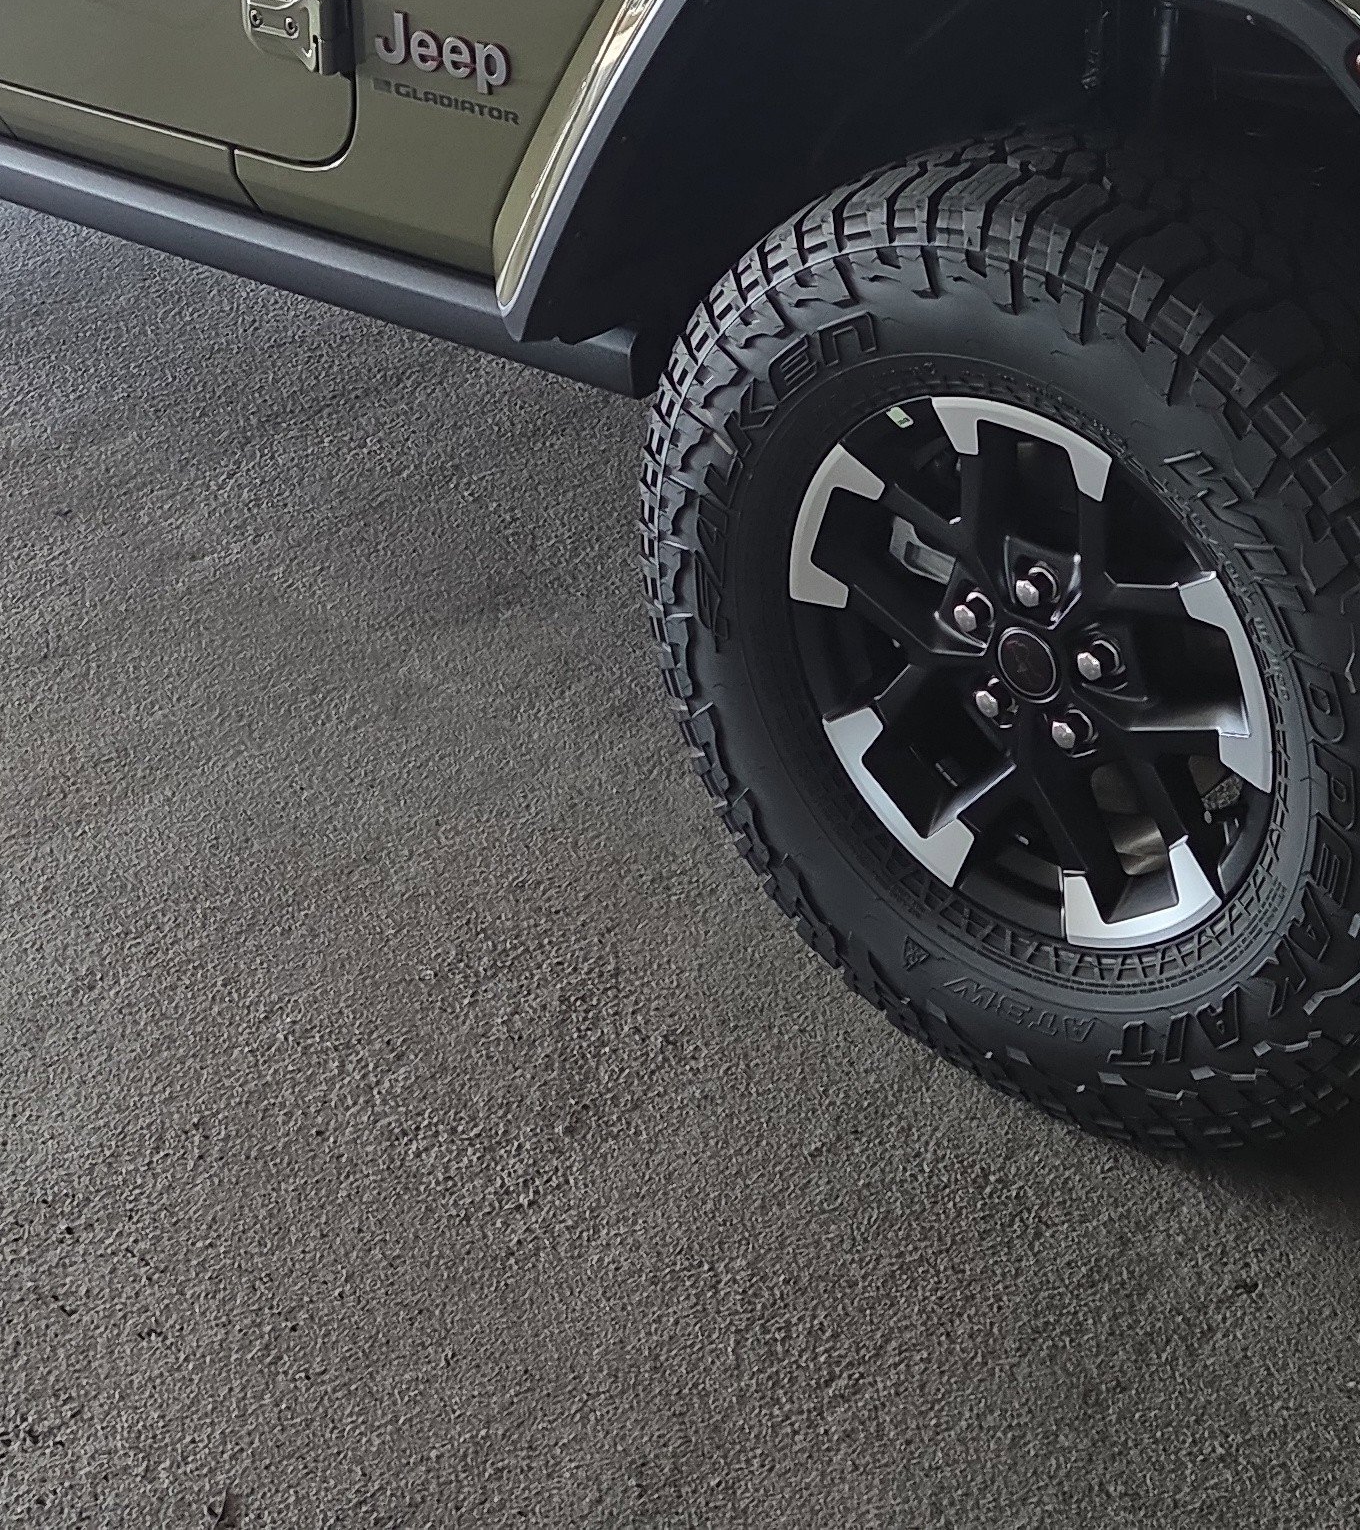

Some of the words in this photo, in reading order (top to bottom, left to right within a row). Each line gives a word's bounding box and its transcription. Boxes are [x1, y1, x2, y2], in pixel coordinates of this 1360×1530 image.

[375, 10, 510, 95] Jeep
[394, 82, 520, 125] GLADIATOR
[1164, 450, 1355, 1018] WILDPEAK
